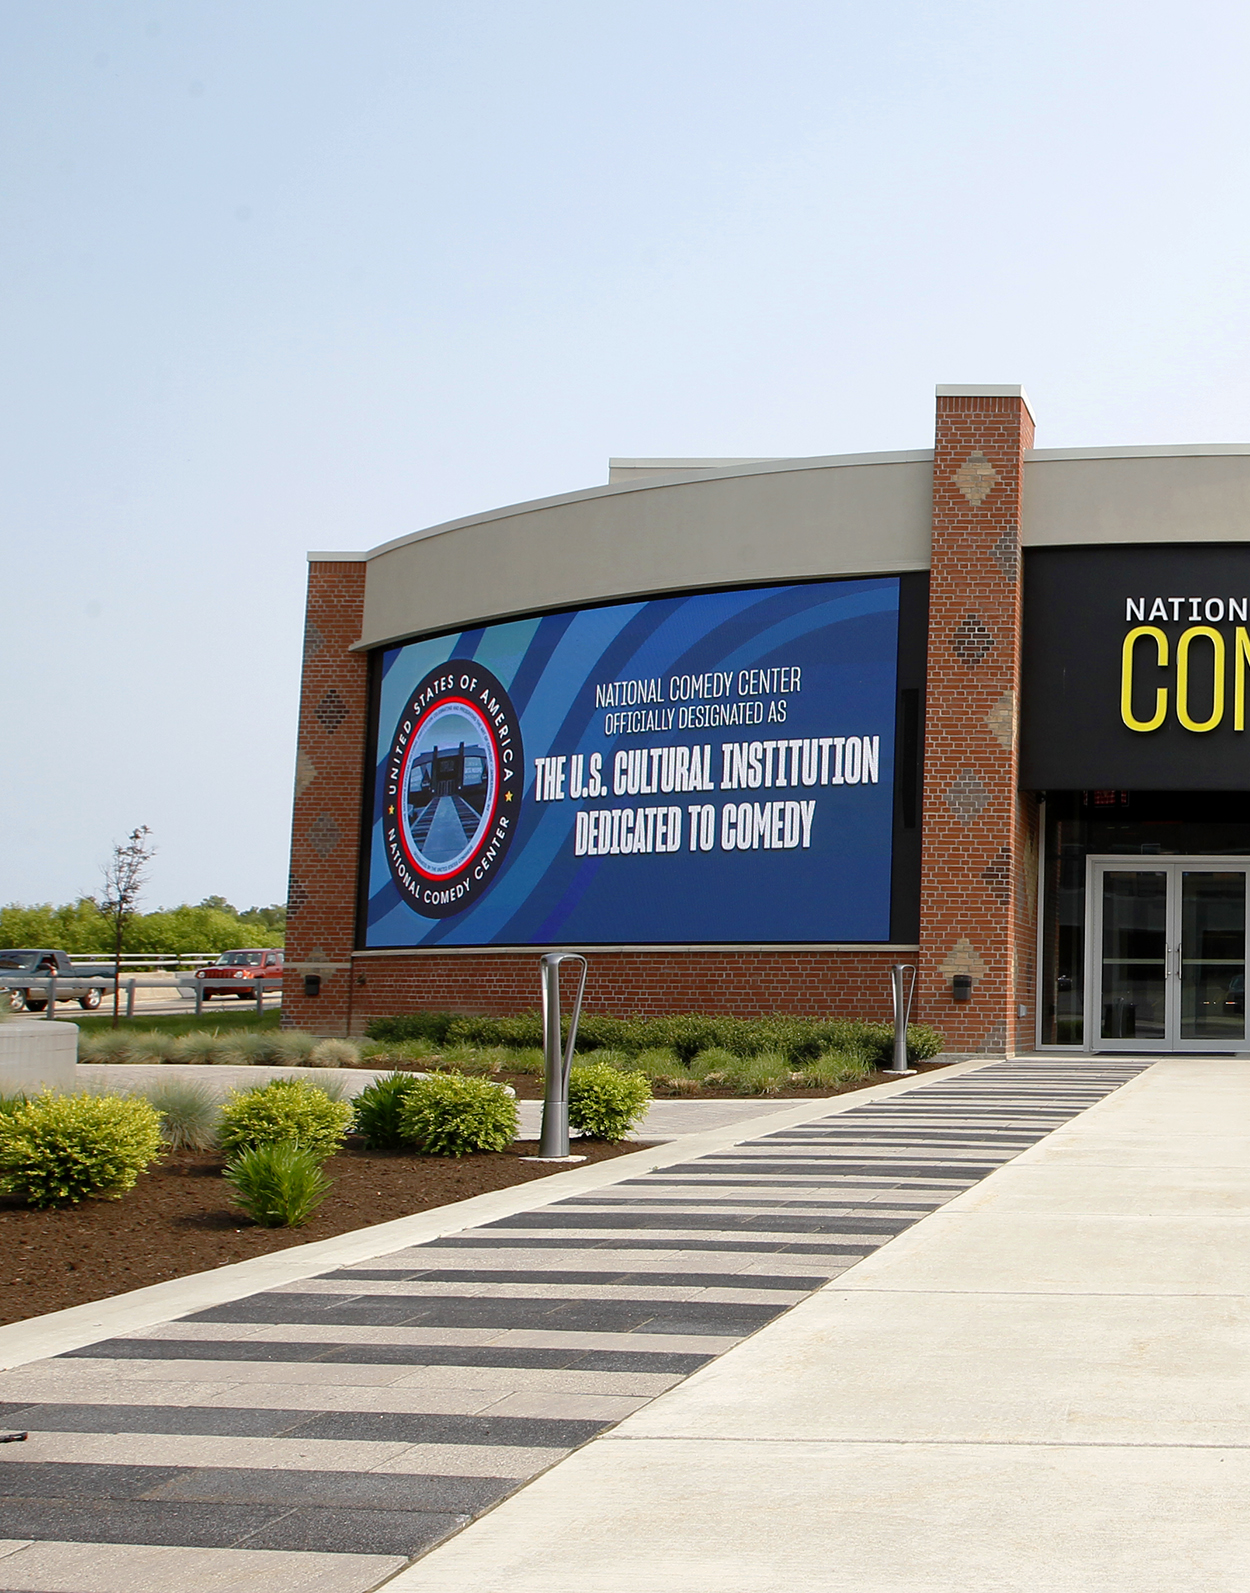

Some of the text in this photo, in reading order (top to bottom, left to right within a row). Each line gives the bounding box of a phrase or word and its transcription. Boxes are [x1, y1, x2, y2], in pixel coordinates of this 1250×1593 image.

[595, 666, 801, 708] NATIONAL COMEDY CENTER
[605, 699, 787, 735] OFFICIALLY DESIGNATED AS
[388, 720, 412, 795] UNITED
[413, 674, 454, 715] STATES
[460, 674, 478, 692] OF
[479, 689, 514, 781] AMERICA
[534, 755, 567, 801] THE
[570, 752, 608, 799] U.S.
[613, 744, 715, 796] CULTURAL
[720, 735, 880, 790] INSTITUTION
[575, 800, 816, 856] DEDICATED TO COMEDY
[388, 828, 421, 900] NATIONAL
[424, 876, 471, 905] COMEDY
[474, 816, 509, 880] CENTER
